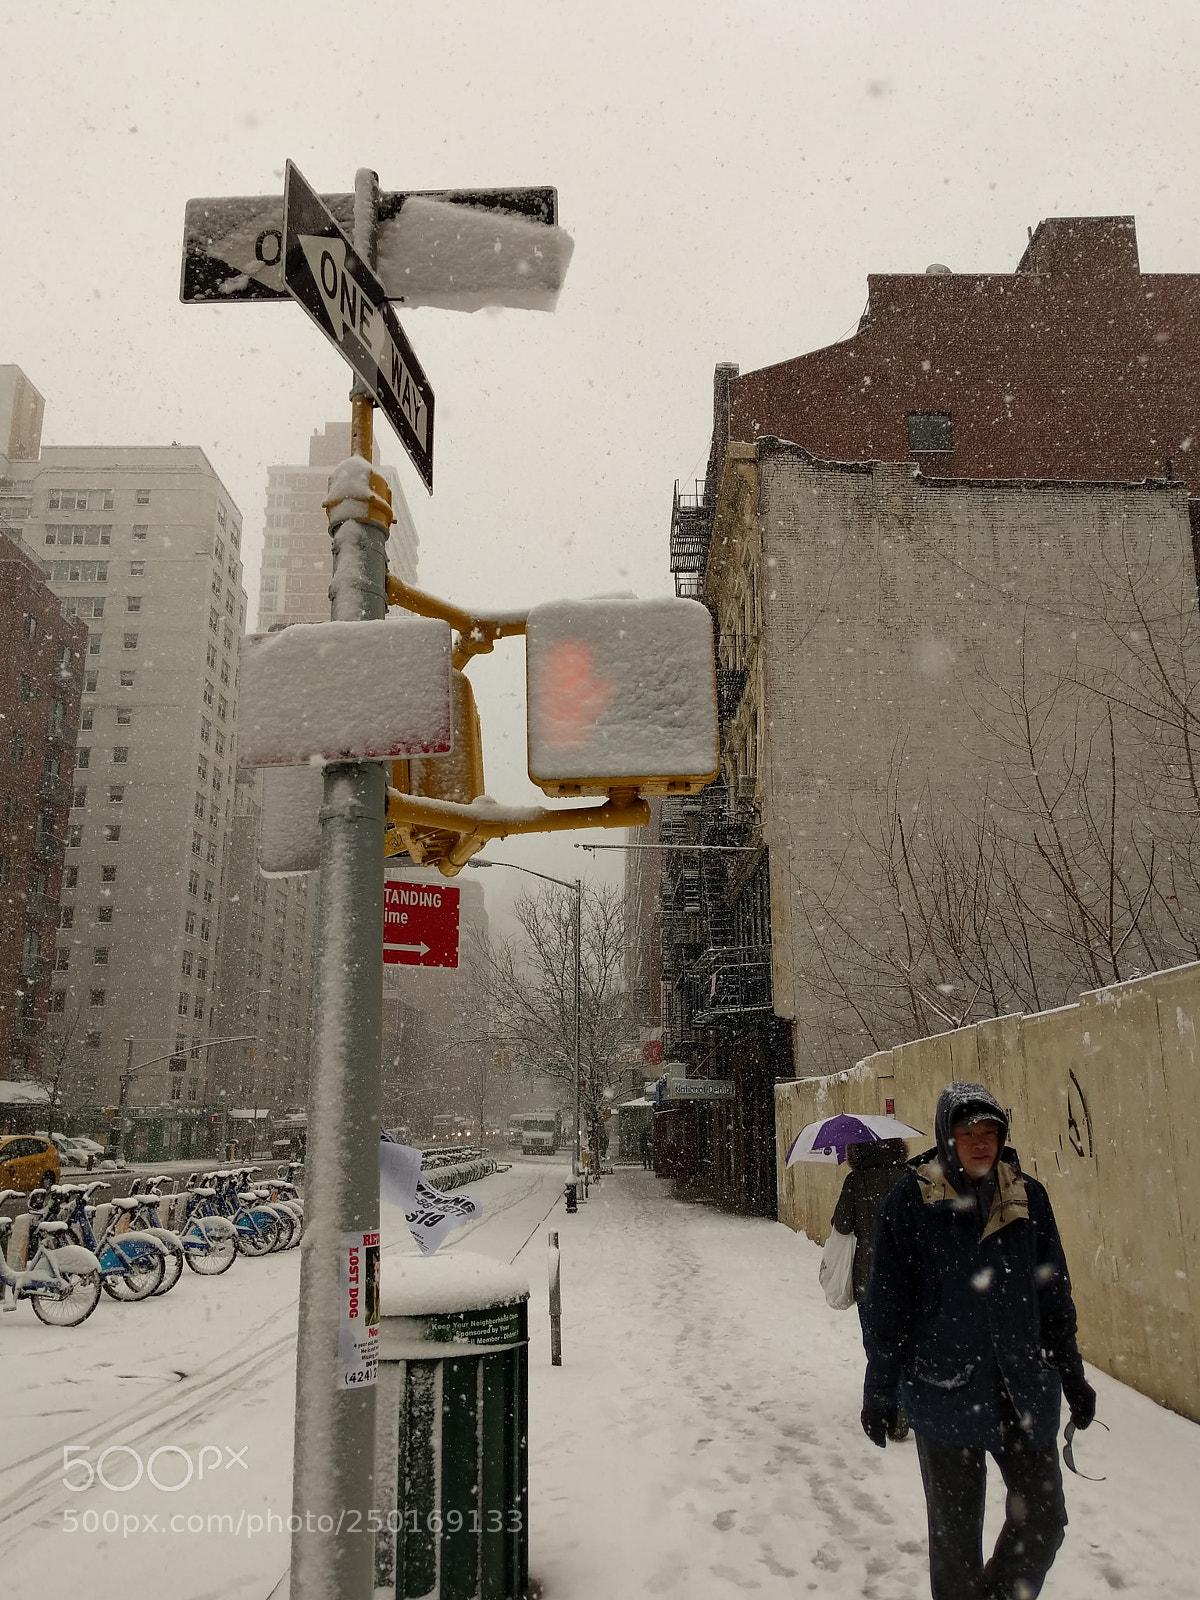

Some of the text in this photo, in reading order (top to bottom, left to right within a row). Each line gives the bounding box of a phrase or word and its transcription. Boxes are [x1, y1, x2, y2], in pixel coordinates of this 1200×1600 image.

[320, 249, 423, 431] ONE WAY
[404, 1209, 446, 1228] $19
[349, 1247, 360, 1319] LOST DOG
[431, 1323, 451, 1331] Keep
[453, 1321, 469, 1329] Your
[470, 1314, 508, 1327] Neighborhood
[455, 1327, 491, 1338] Sponsored
[491, 1326, 499, 1334] by
[476, 1335, 500, 1344] Member
[345, 1367, 373, 1385] (424)
